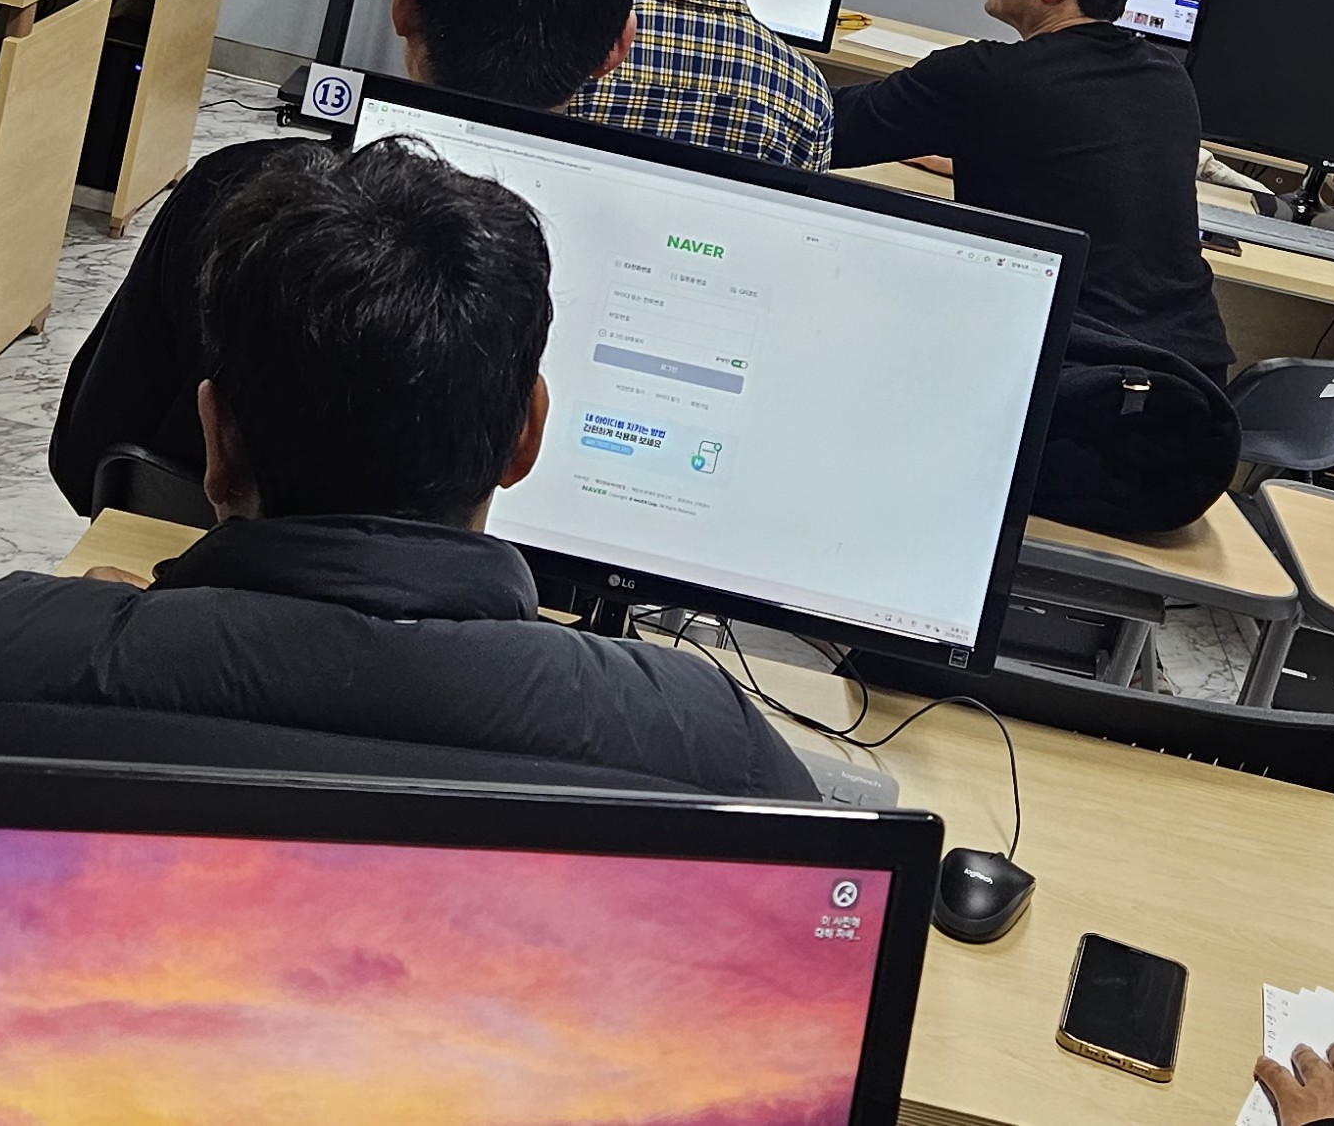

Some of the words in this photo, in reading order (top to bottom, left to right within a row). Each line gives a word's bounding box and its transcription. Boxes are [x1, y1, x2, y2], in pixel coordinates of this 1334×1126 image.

[666, 234, 725, 259] NAVER
[583, 423, 614, 437] 간편하게
[639, 436, 662, 448] 보세요
[595, 415, 625, 429] 아이디를
[627, 422, 649, 434] 지키는
[582, 484, 608, 496] NAVER
